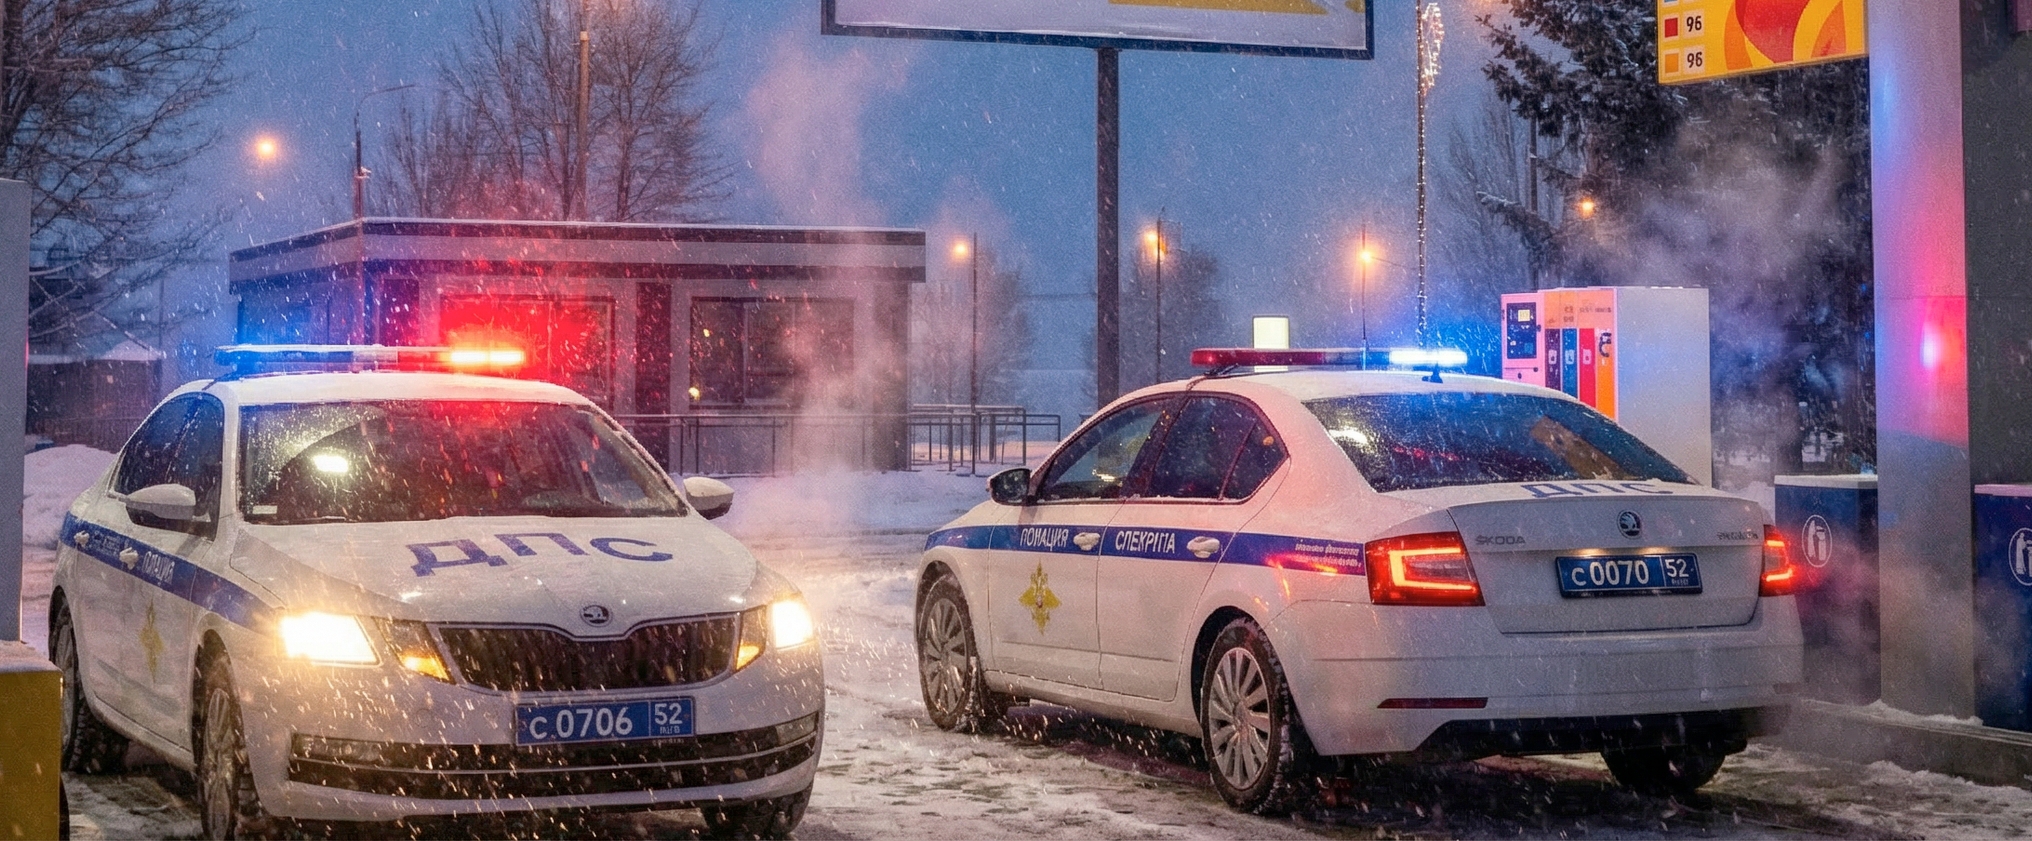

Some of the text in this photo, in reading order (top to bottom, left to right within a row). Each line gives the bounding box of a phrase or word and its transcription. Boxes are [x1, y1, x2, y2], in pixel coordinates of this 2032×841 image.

[1686, 15, 1702, 32] 96
[1687, 51, 1703, 68] 96
[1520, 483, 1673, 498] ДПС
[405, 533, 673, 577] ДПС
[1665, 559, 1689, 578] 52
[655, 703, 683, 725] 52
